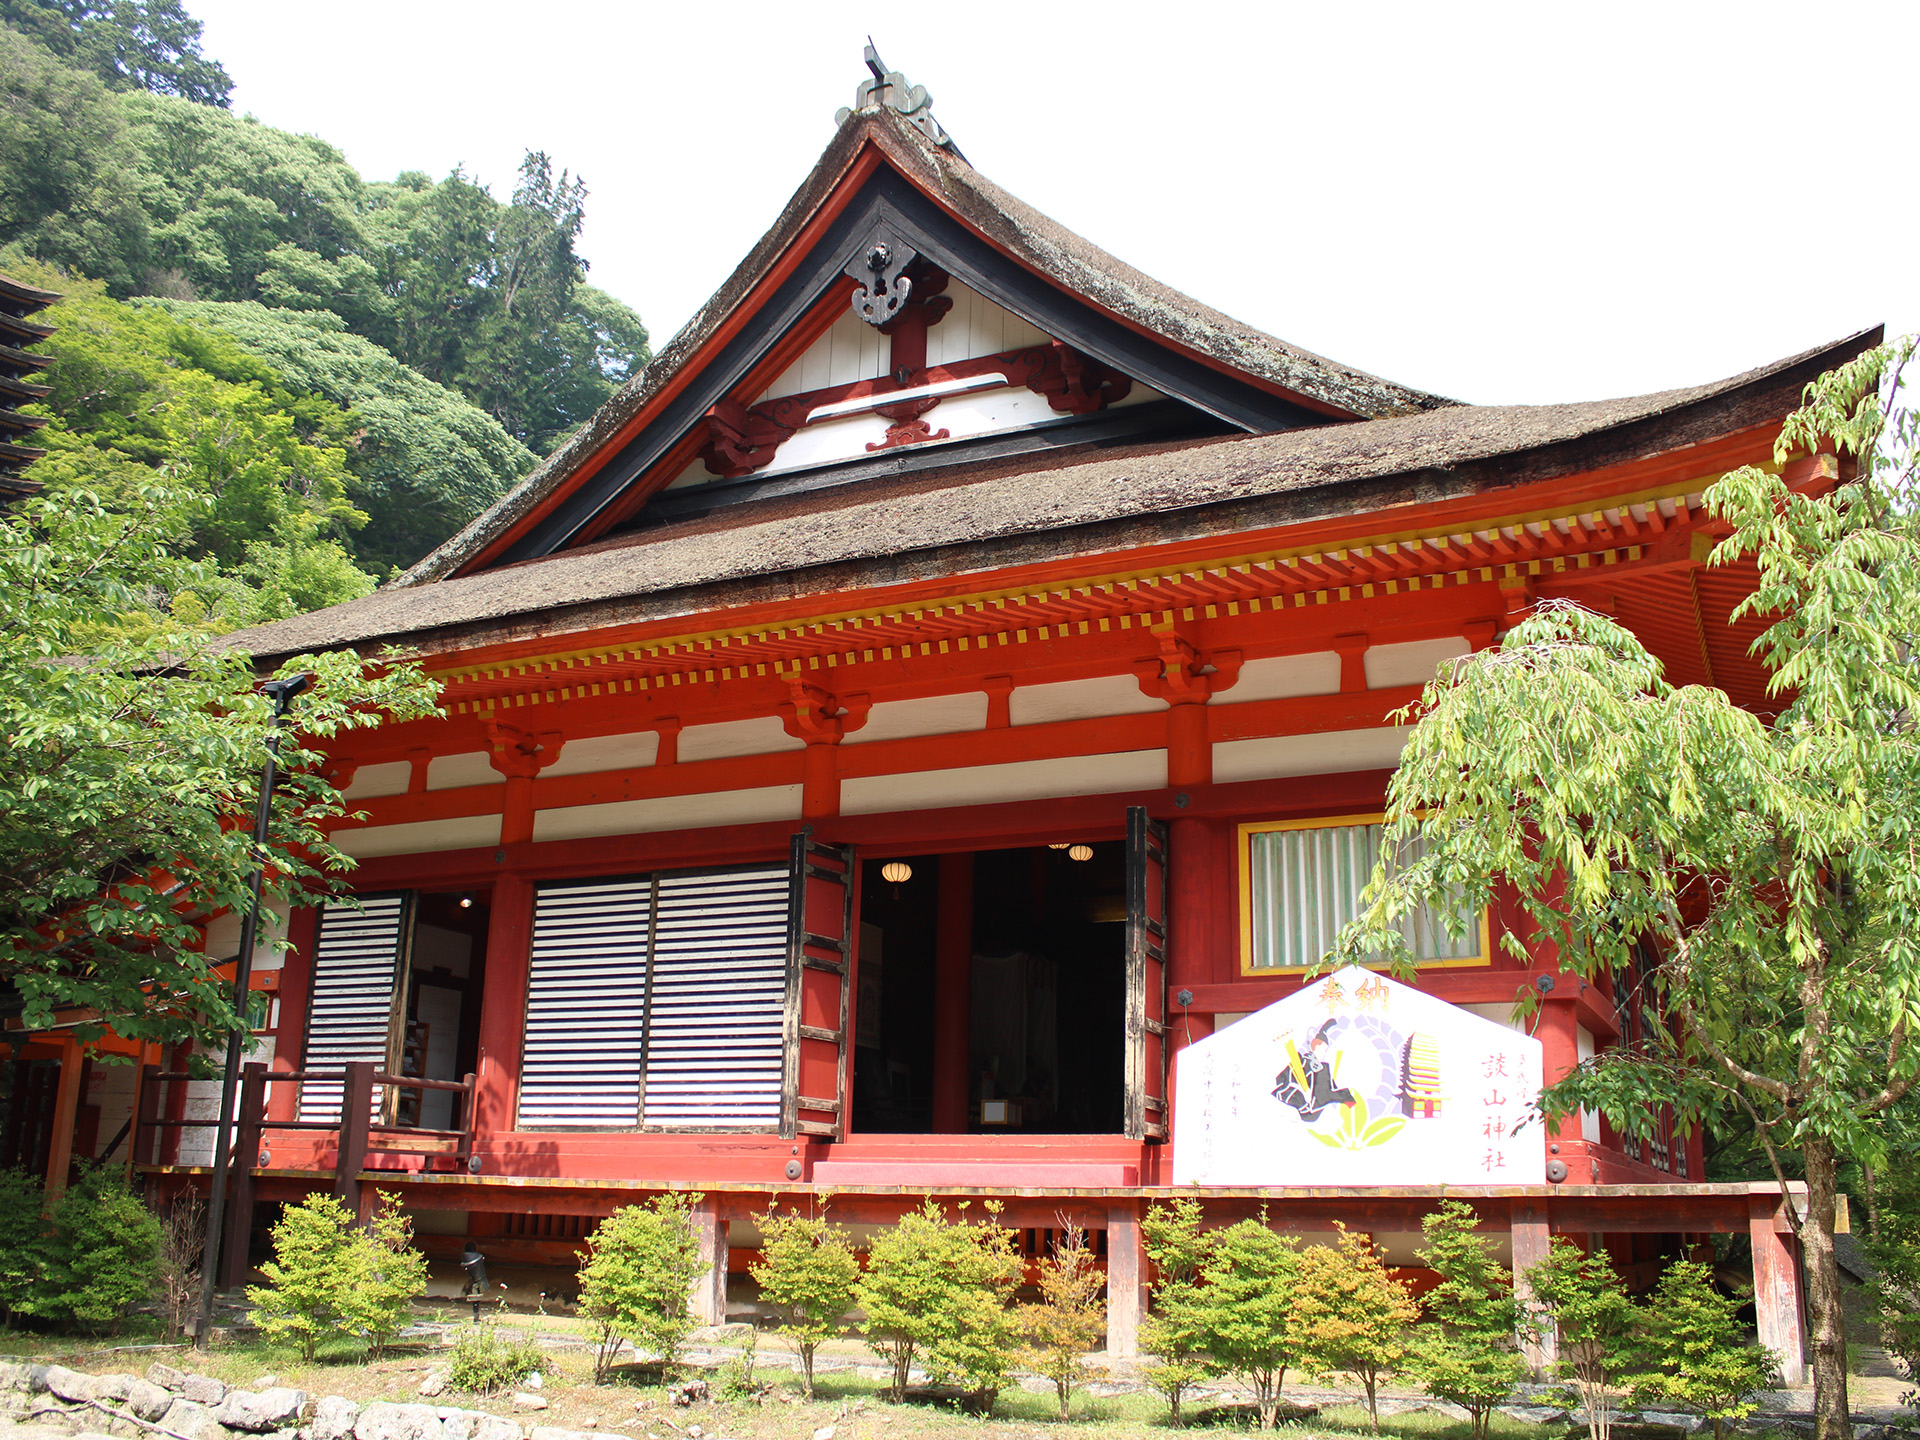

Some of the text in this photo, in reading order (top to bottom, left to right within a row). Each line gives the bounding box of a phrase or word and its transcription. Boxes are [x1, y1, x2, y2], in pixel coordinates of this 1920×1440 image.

[1315, 976, 1390, 1015] 奉納
[1481, 1052, 1509, 1173] 談山神社
